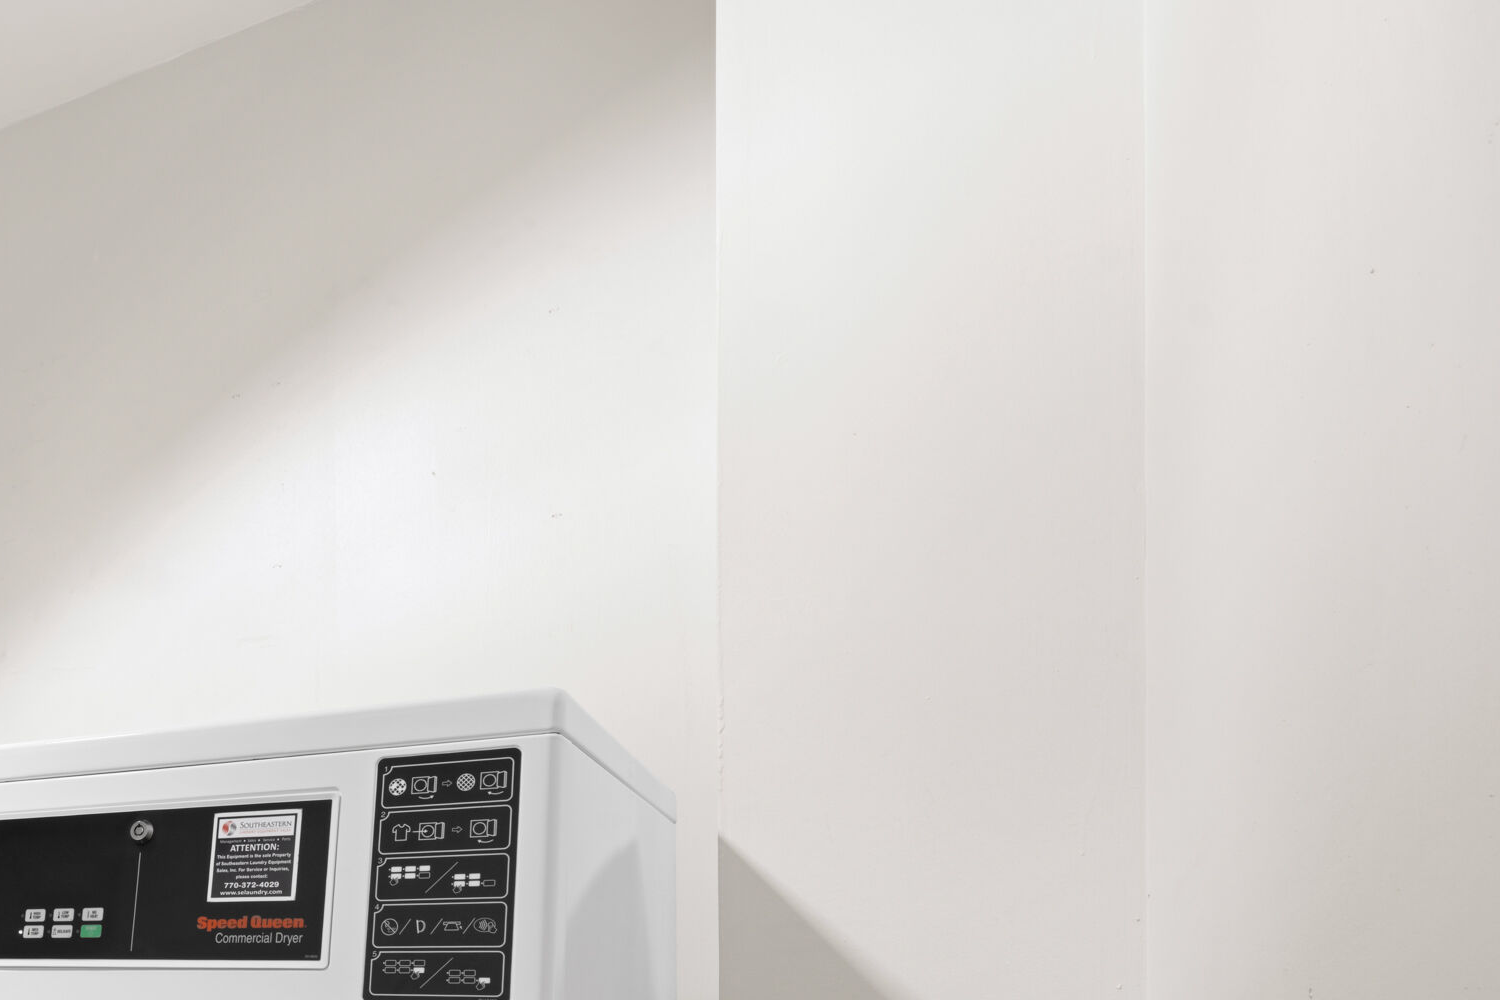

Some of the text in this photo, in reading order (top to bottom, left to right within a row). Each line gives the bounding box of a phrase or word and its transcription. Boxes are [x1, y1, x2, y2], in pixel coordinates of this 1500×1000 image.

[230, 843, 280, 852] ATTENTION:
[224, 881, 279, 889] 770-372-4029
[197, 915, 304, 932] Speed Queen
[215, 932, 303, 946] Commercial Dryer
